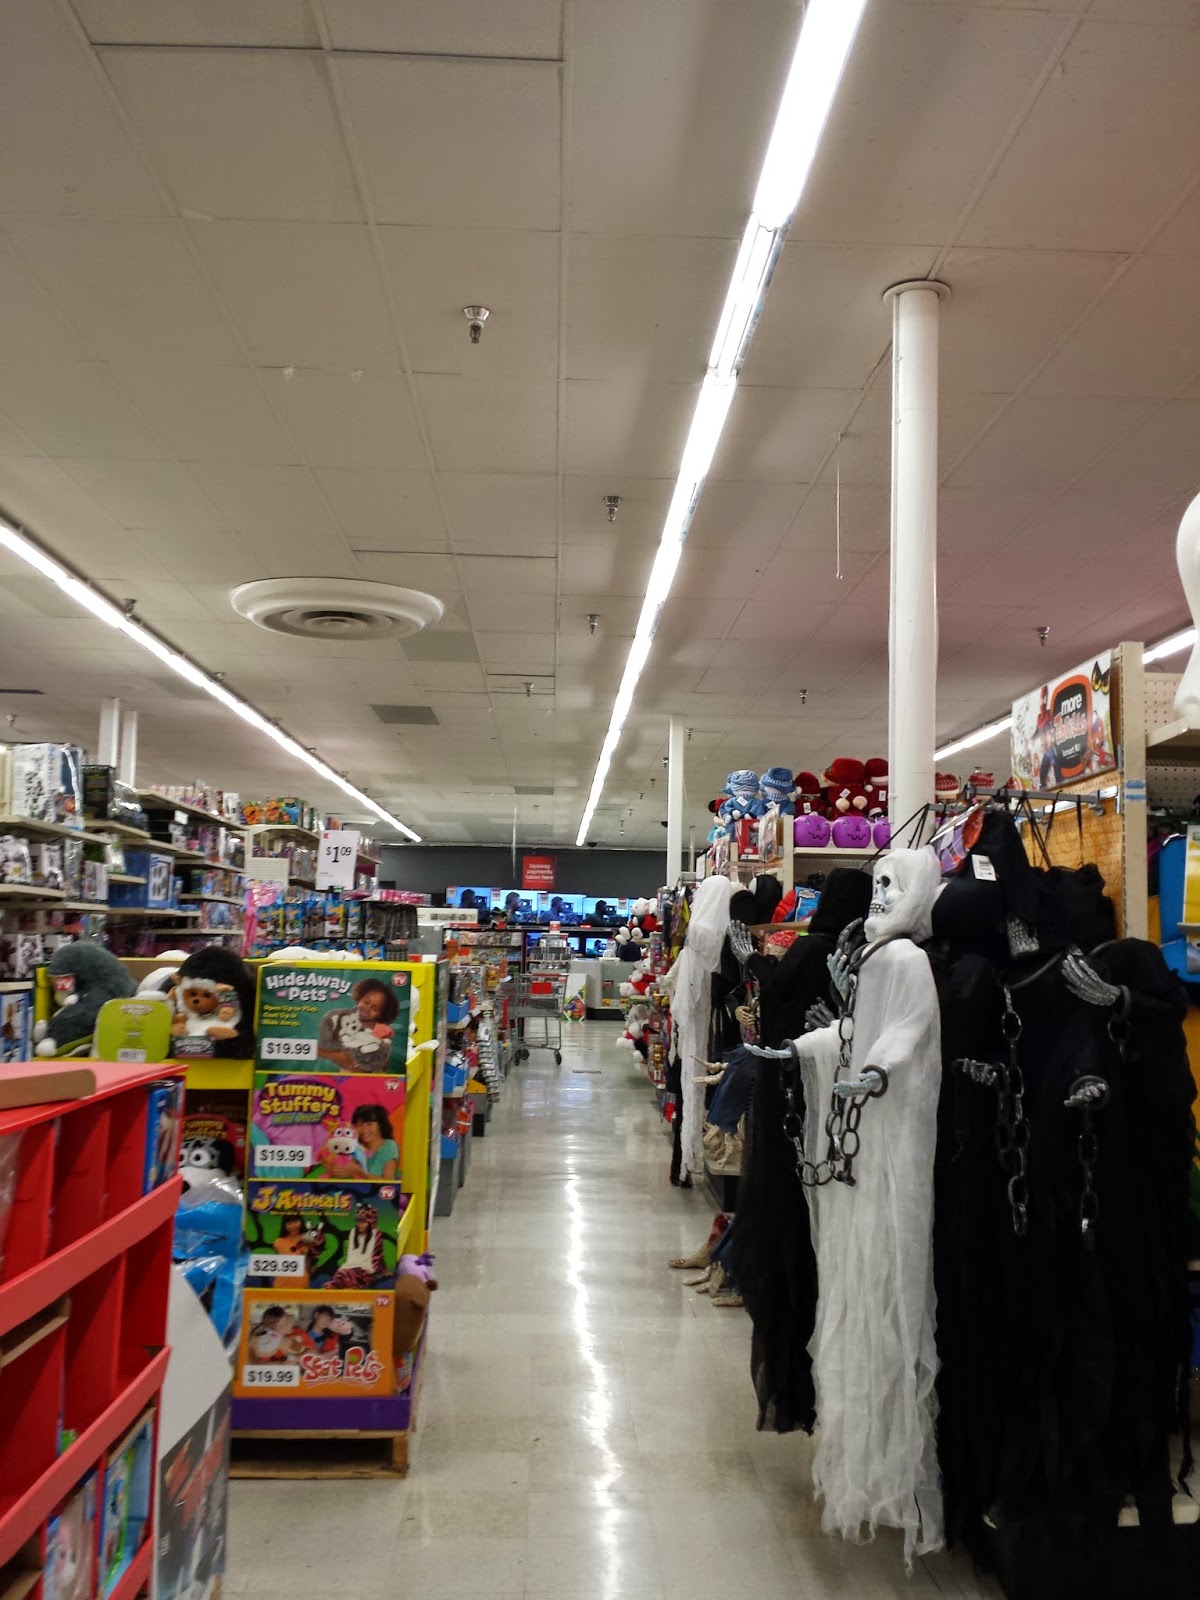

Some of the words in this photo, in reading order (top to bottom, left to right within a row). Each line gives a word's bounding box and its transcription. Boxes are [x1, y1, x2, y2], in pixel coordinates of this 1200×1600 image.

[1061, 693, 1083, 716] more
[265, 971, 352, 994] HideAway
[288, 987, 328, 1002] Pets
[266, 1042, 311, 1055] $19.99
[264, 1082, 336, 1101] Tummy
[386, 1080, 400, 1091] TV
[259, 1096, 340, 1117] Stuffers
[259, 1149, 305, 1162] $19.99
[275, 1187, 352, 1211] Animals
[381, 1189, 394, 1198] TV
[252, 1260, 298, 1273] $29.99
[247, 1370, 293, 1383] $19.99
